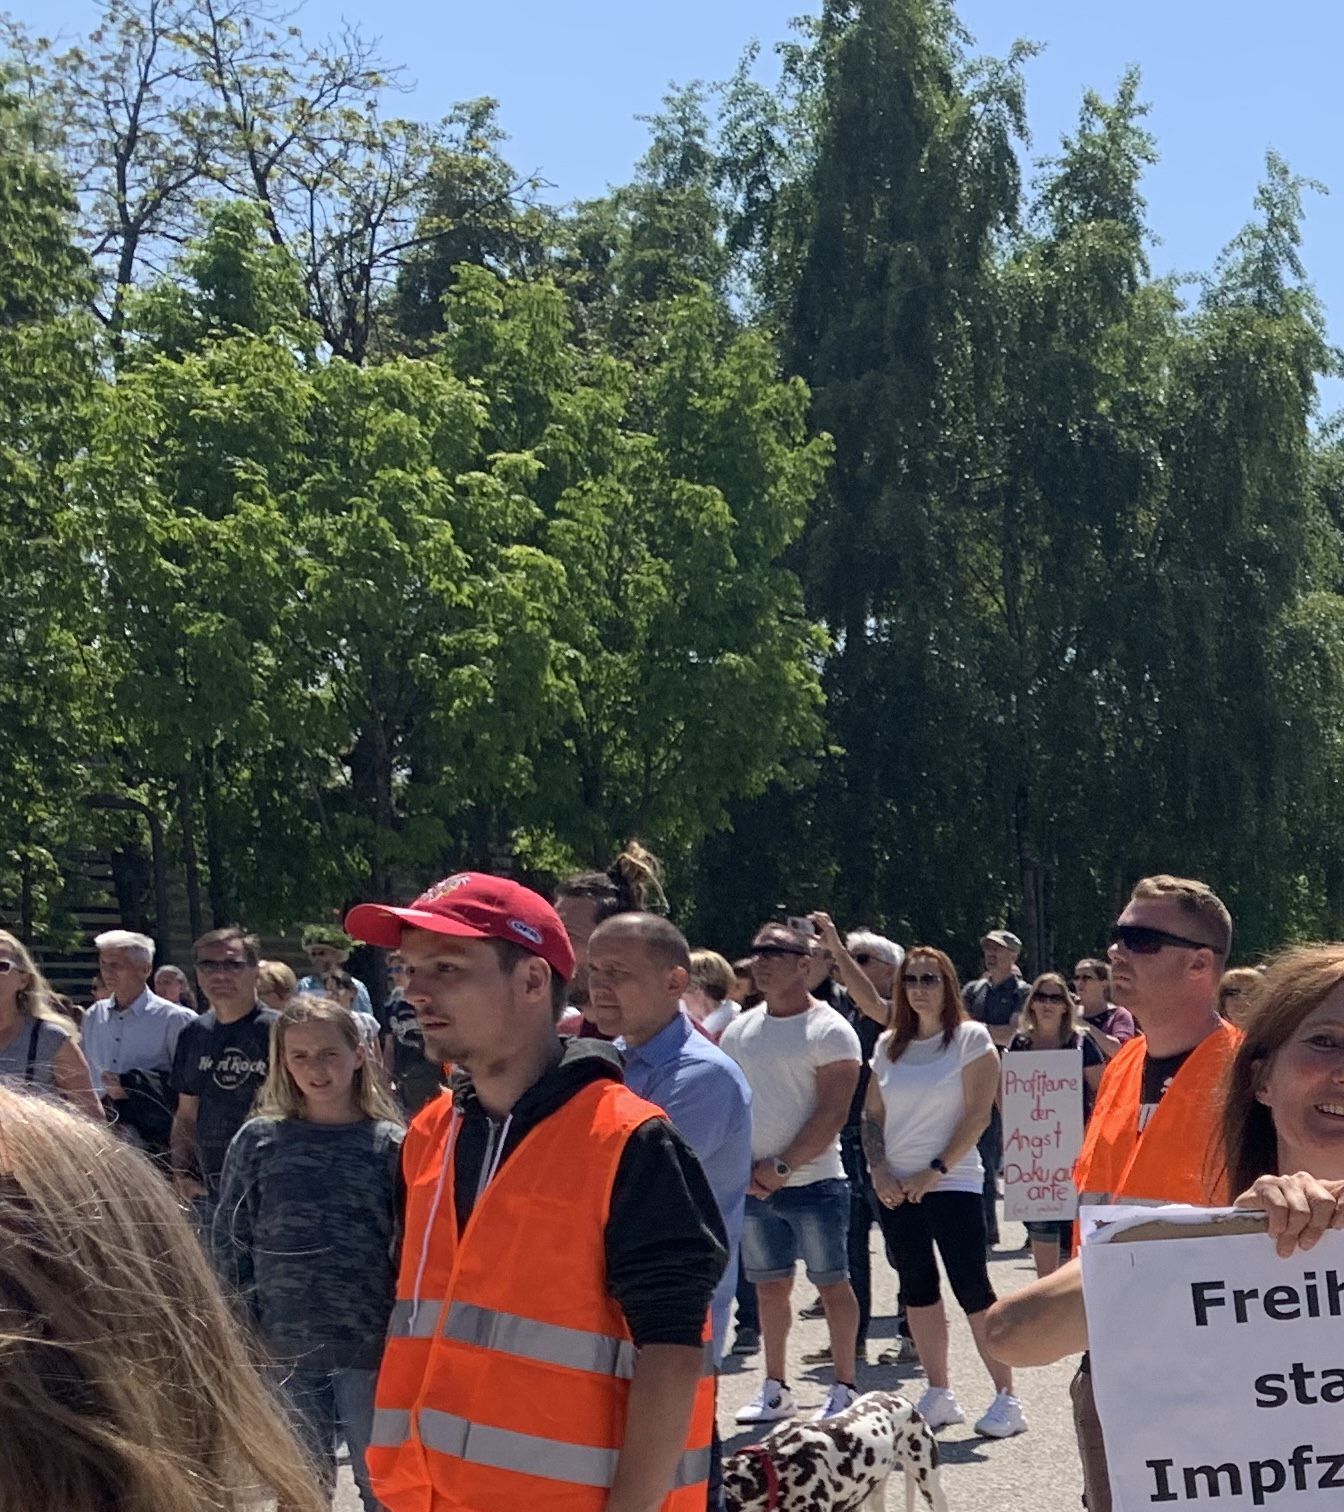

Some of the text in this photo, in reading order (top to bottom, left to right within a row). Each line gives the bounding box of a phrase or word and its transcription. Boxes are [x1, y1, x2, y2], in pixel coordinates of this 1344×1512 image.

[1030, 1095, 1056, 1121] der
[1005, 1121, 1062, 1159] Angst
[1005, 1159, 1049, 1185] Doku
[1027, 1180, 1068, 1201] arte
